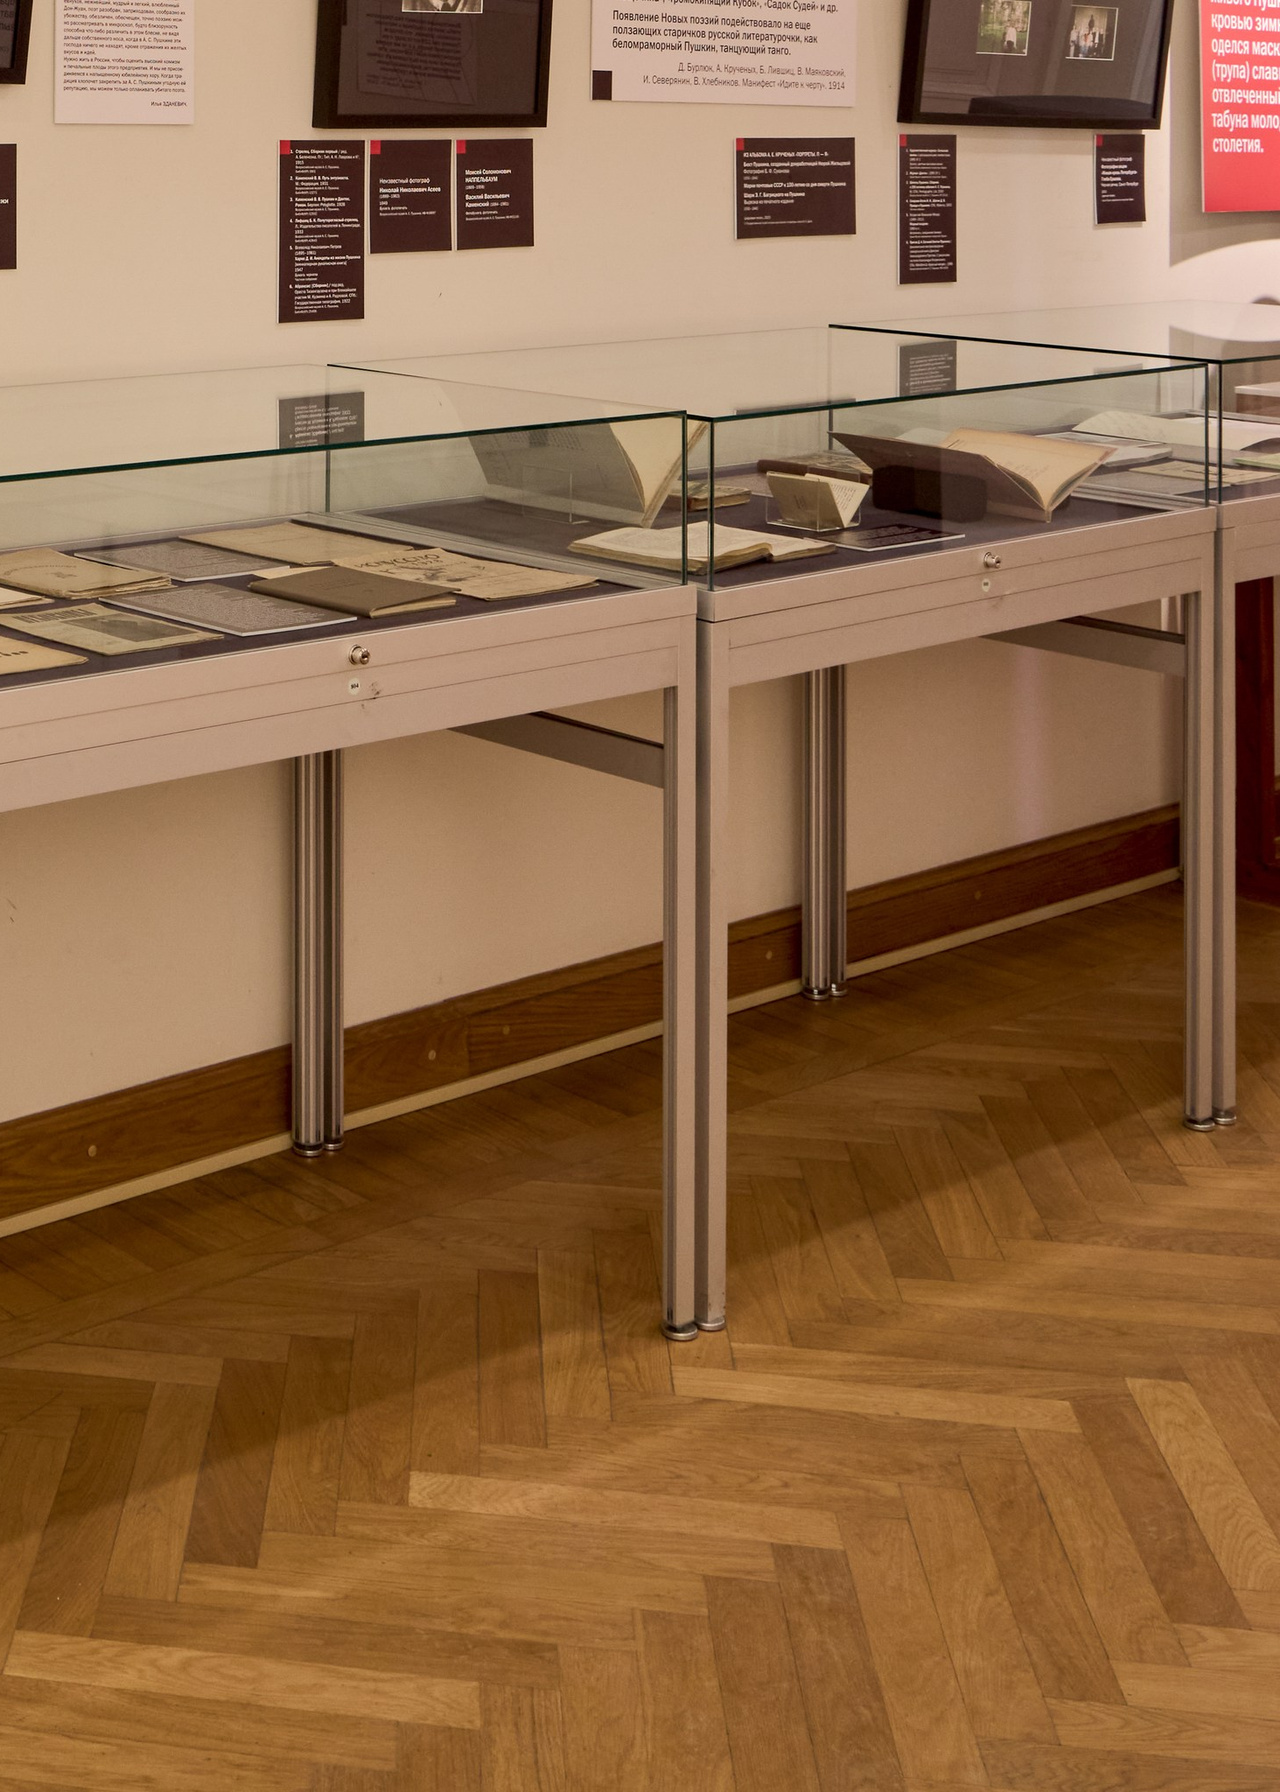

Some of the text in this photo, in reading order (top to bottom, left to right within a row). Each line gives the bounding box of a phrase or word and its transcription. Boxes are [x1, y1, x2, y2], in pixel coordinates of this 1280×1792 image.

[612, 9, 811, 31] Появление Новых поэзий подействовало на еще
[1211, 137, 1265, 154] столетия.
